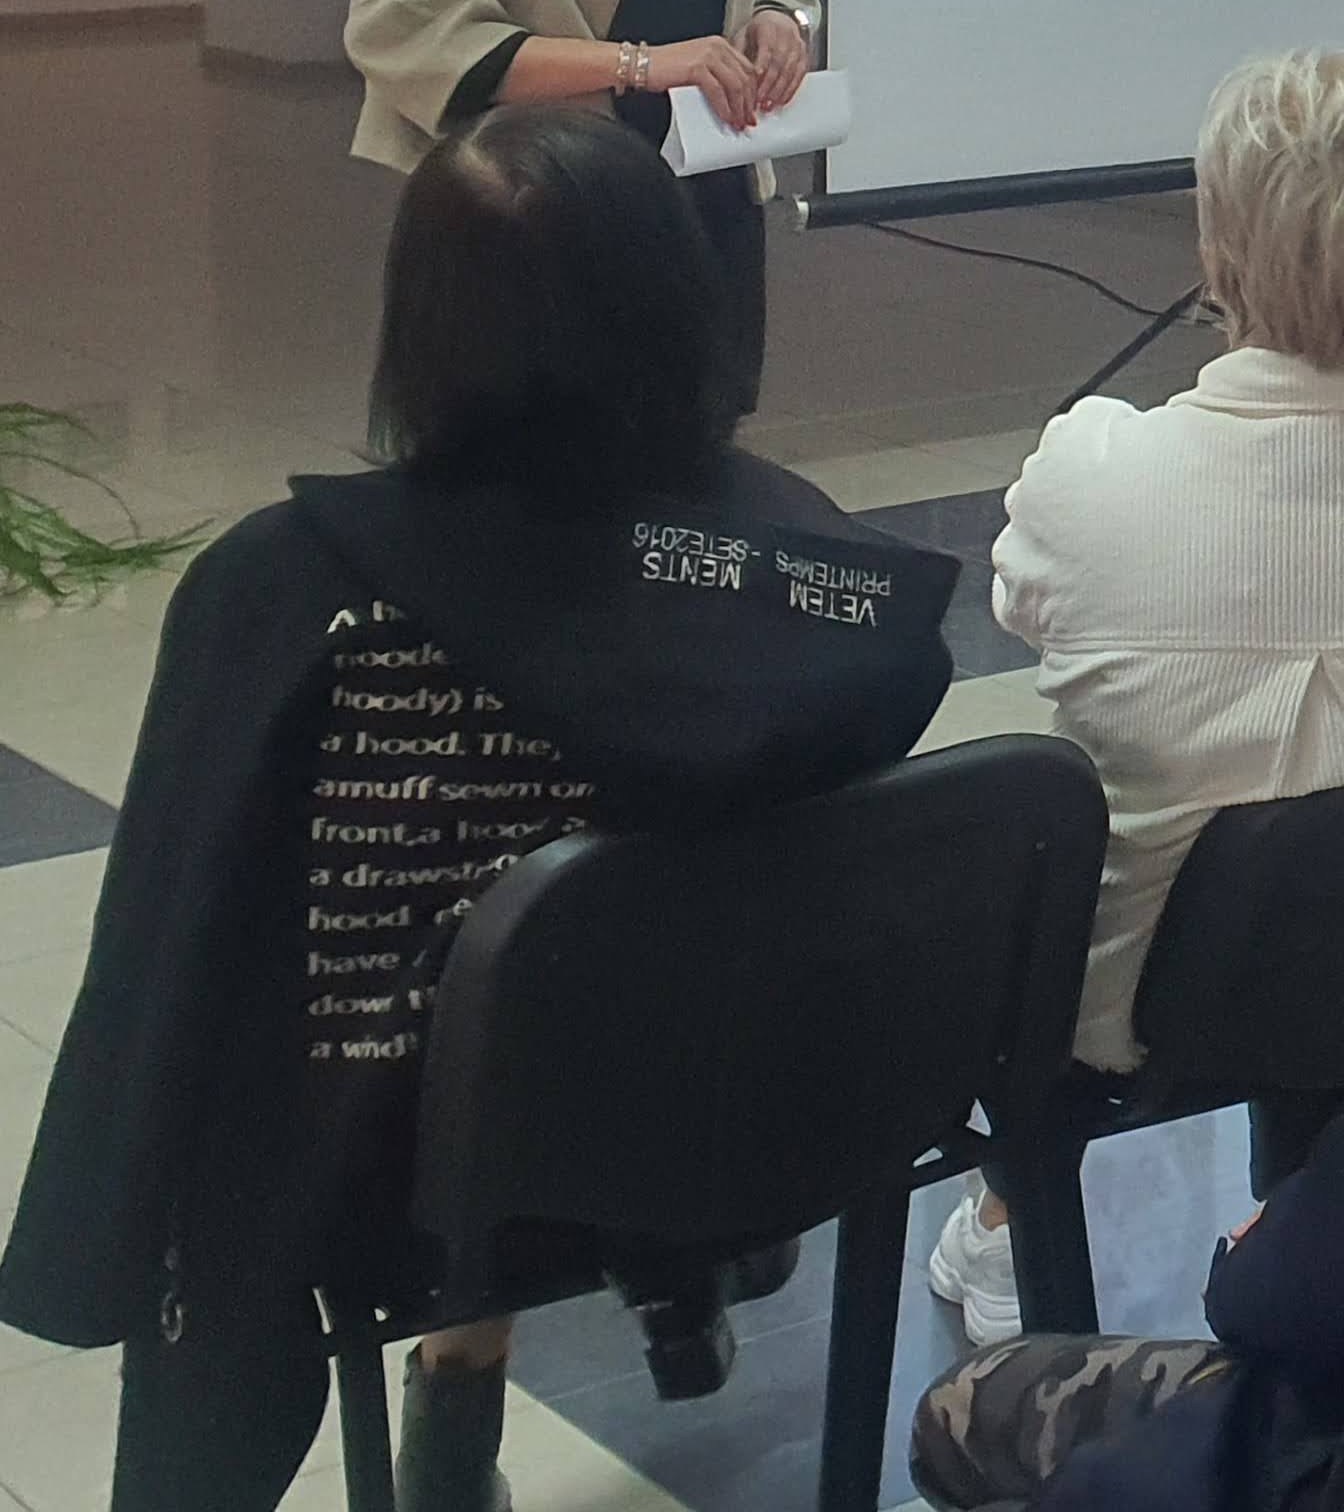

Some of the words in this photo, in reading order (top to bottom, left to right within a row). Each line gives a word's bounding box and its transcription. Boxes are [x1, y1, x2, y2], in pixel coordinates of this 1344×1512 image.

[641, 551, 741, 590] MENTS
[775, 550, 891, 596] PRINTEMPS
[309, 867, 331, 887] a
[308, 904, 411, 931] hood
[307, 950, 401, 976] have
